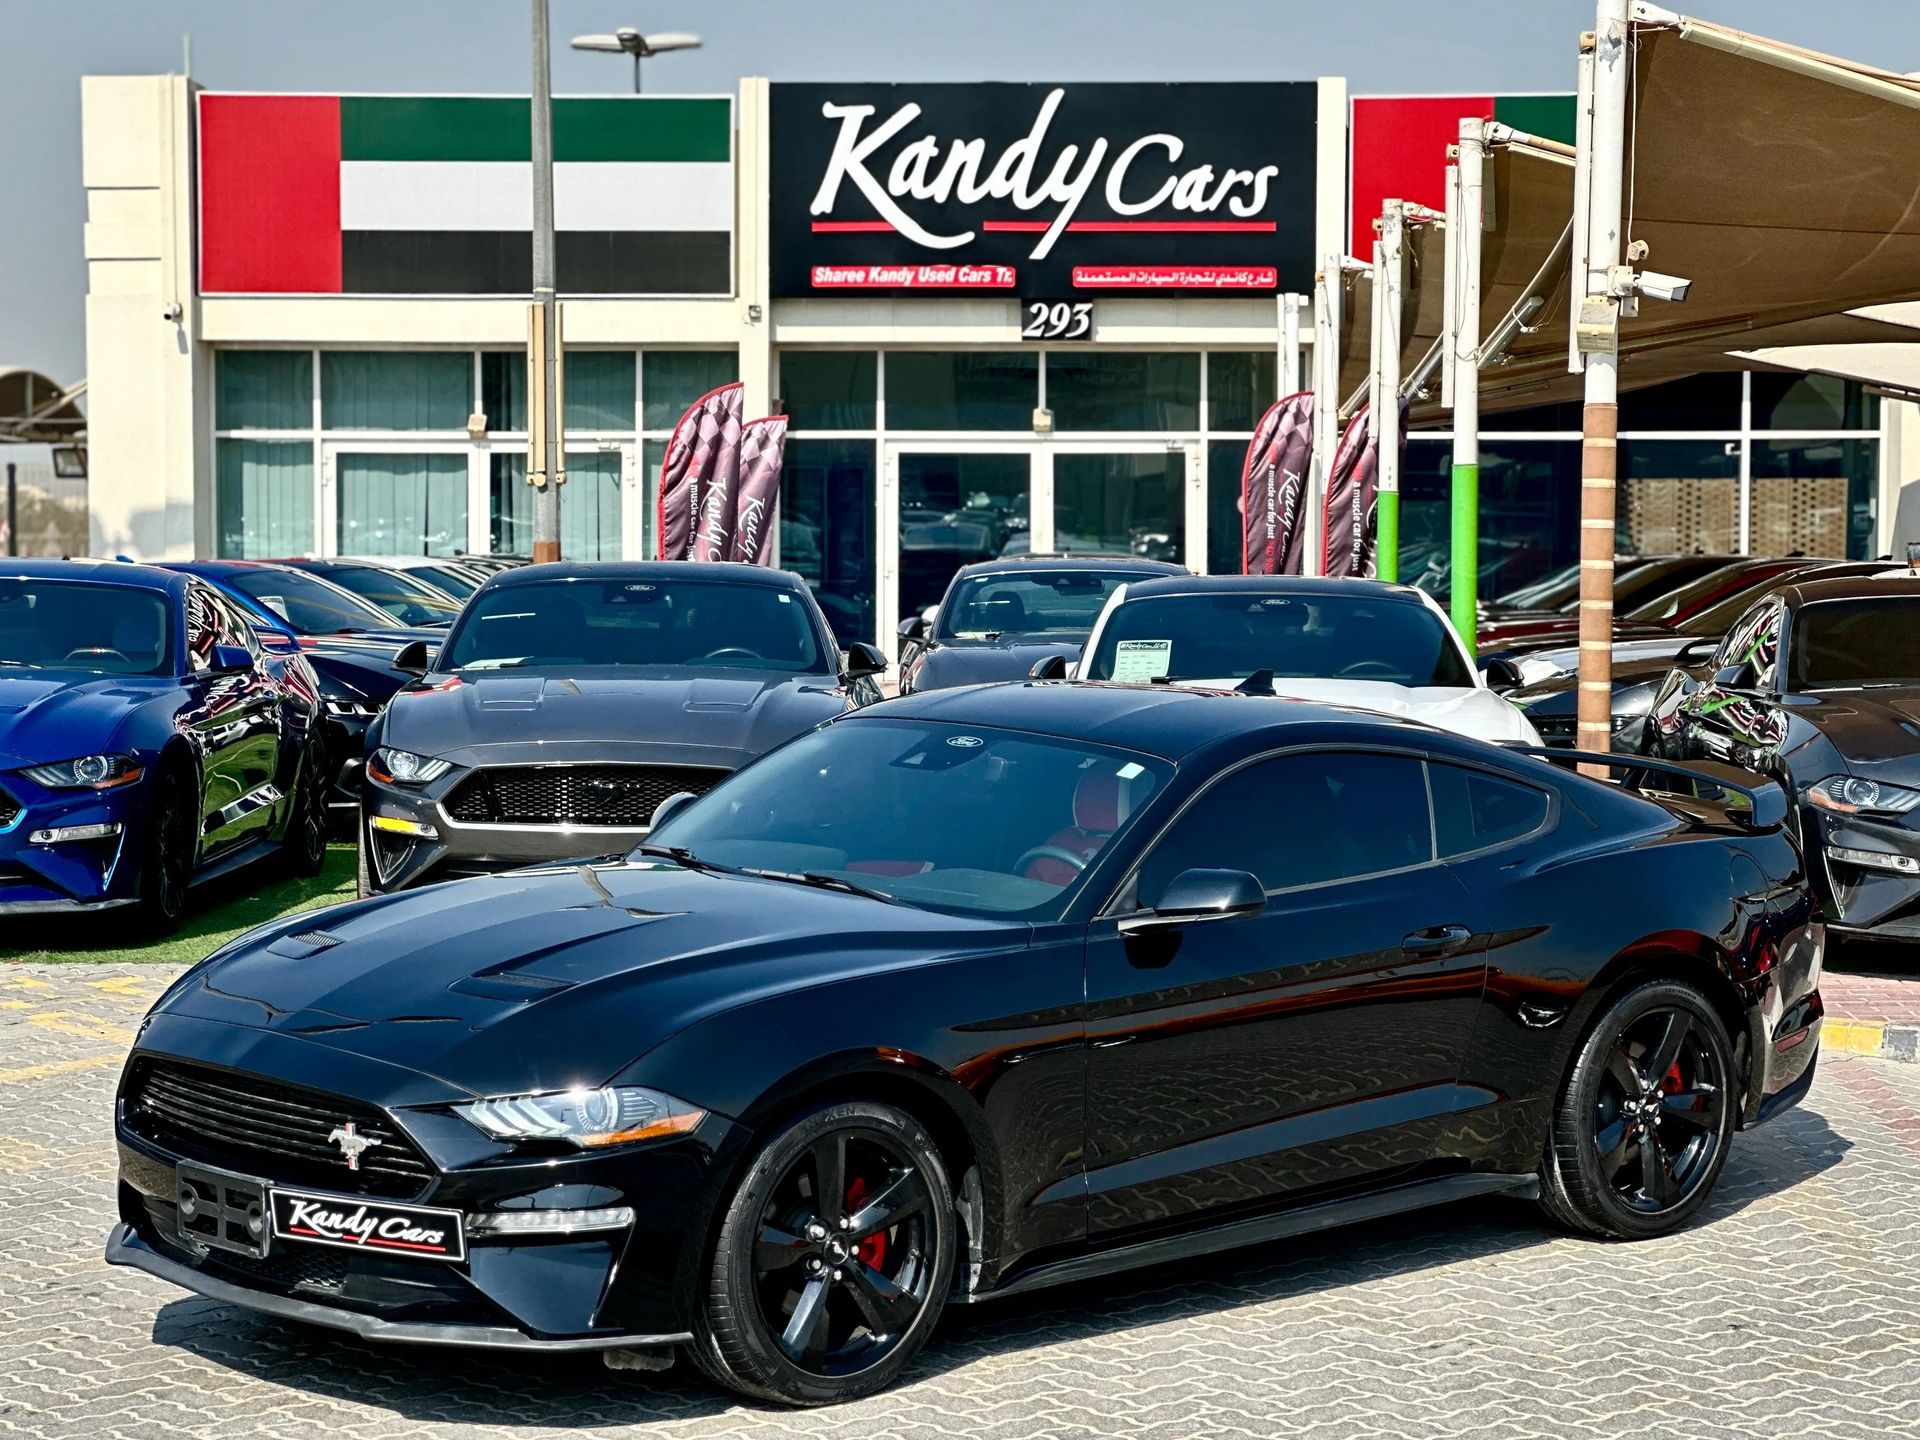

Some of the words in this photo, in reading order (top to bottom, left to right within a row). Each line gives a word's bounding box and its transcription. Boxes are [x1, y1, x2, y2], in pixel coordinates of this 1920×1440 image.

[809, 88, 1109, 260] Kandy
[1105, 133, 1279, 217] Cars
[814, 267, 865, 283] Sharee
[868, 267, 914, 286] Kandy
[918, 267, 954, 282] Used
[958, 267, 992, 282] Cars
[996, 267, 1013, 282] Tr.
[1136, 271, 1179, 286] السيارات
[1179, 271, 1216, 286] لتجارة
[1216, 271, 1247, 287] كاندي
[1247, 271, 1274, 286] شارع
[1022, 302, 1093, 338] 293
[1268, 470, 1277, 498] muscle
[690, 484, 699, 516] muscle
[1267, 499, 1275, 510] car
[1352, 489, 1363, 522] muscle
[697, 477, 728, 546] Kandy
[1268, 511, 1277, 523] for
[737, 495, 766, 559] Kandy
[1266, 523, 1276, 540] just
[1352, 522, 1362, 537] car
[1352, 538, 1363, 552] for
[1350, 552, 1361, 572] just
[289, 1199, 378, 1245] Kandy
[379, 1217, 445, 1243] Cars
